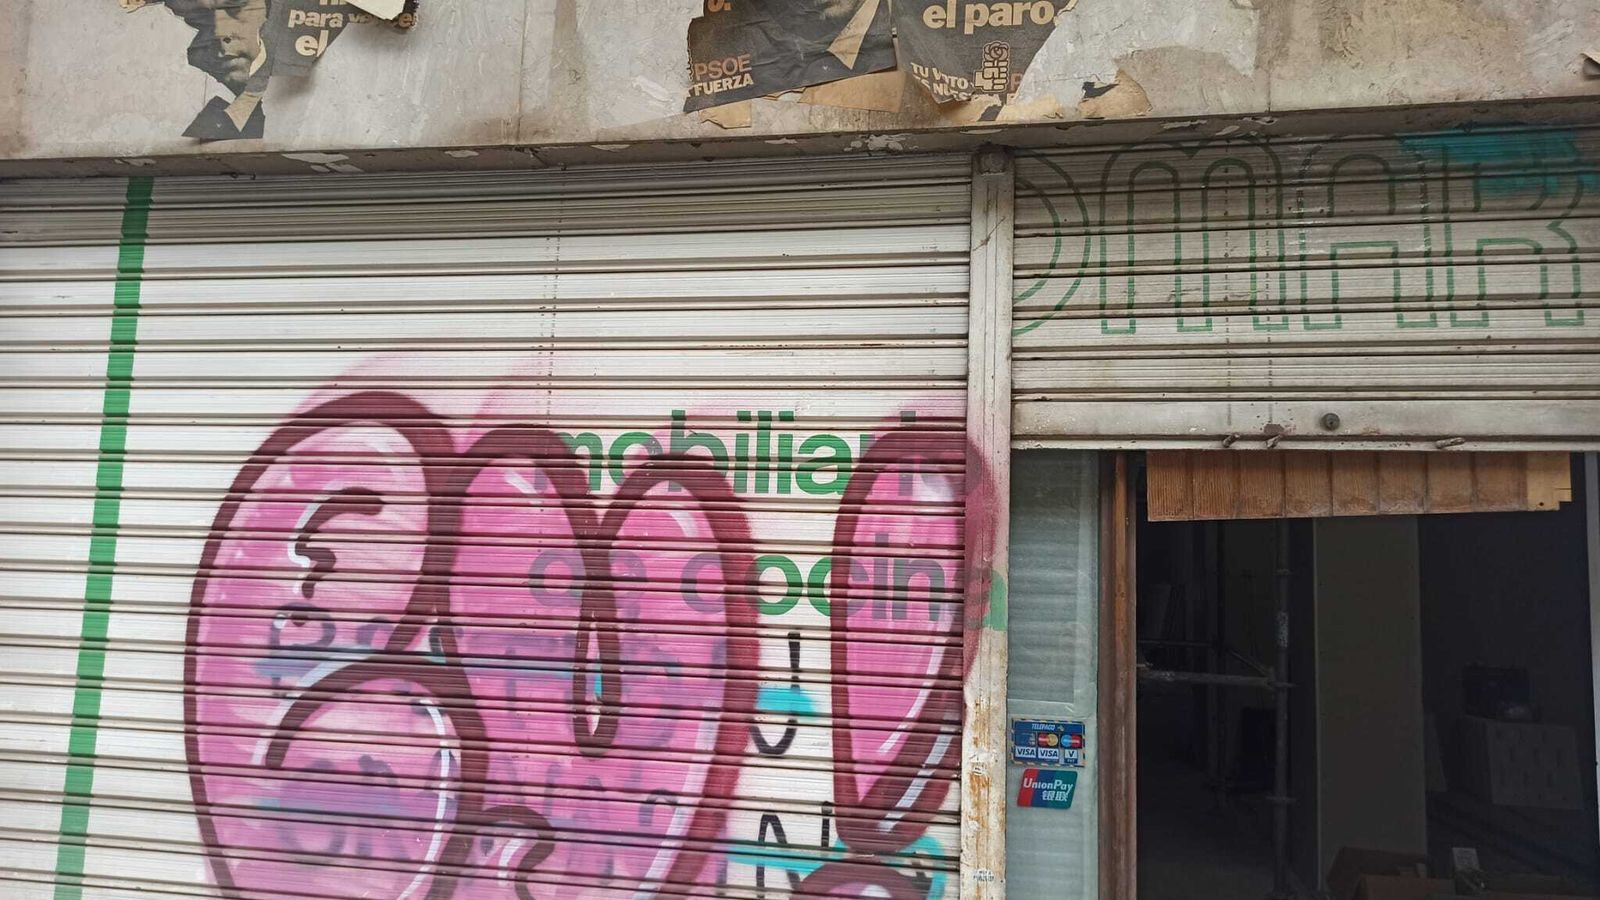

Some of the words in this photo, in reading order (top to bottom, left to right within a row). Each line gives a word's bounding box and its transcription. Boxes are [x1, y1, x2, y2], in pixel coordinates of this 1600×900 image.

[287, 9, 344, 28] para
[923, 0, 957, 29] el
[295, 30, 329, 57] el
[694, 53, 753, 80] PSOE
[910, 62, 929, 78] TU
[693, 73, 754, 96] FUERZA
[1023, 778, 1073, 795] UnionPay
